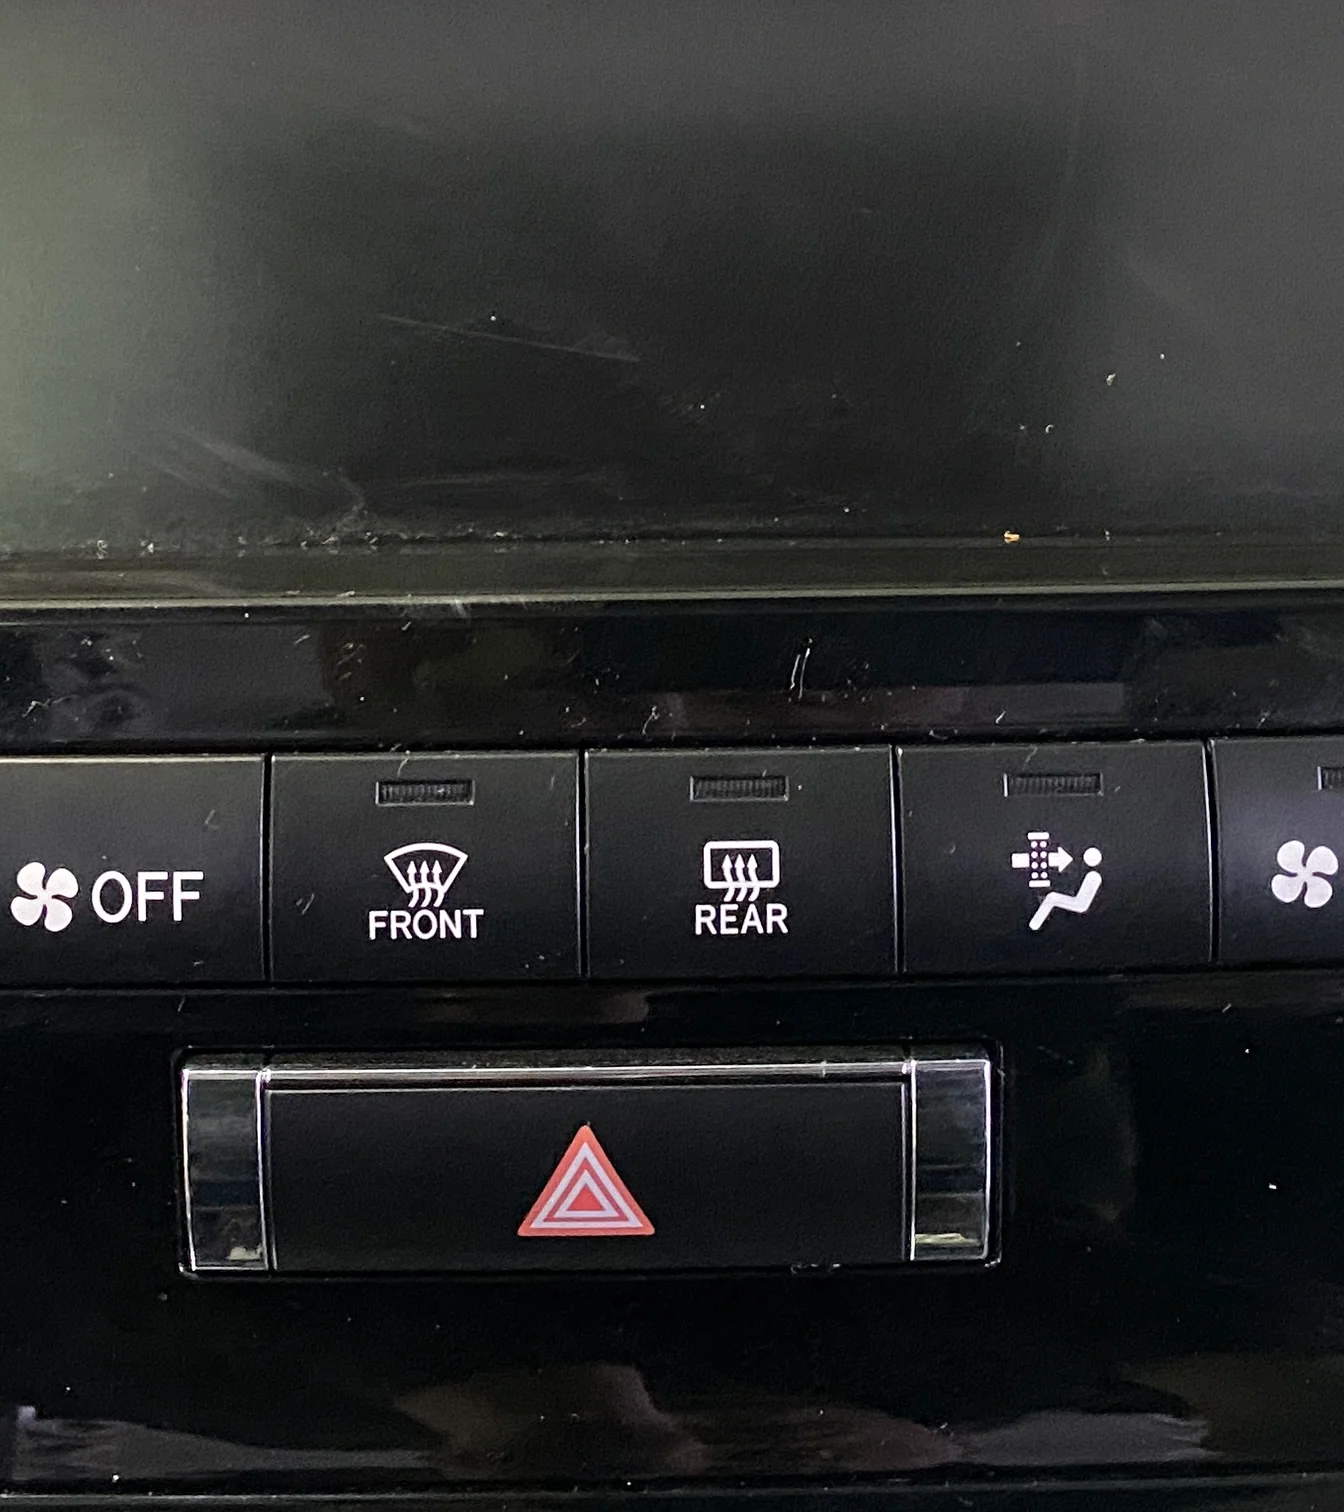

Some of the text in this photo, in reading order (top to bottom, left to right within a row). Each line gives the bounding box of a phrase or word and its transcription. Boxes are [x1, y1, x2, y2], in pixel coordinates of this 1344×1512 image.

[91, 870, 204, 922] OFF
[368, 908, 484, 940] FRONT
[694, 903, 788, 934] REAR
